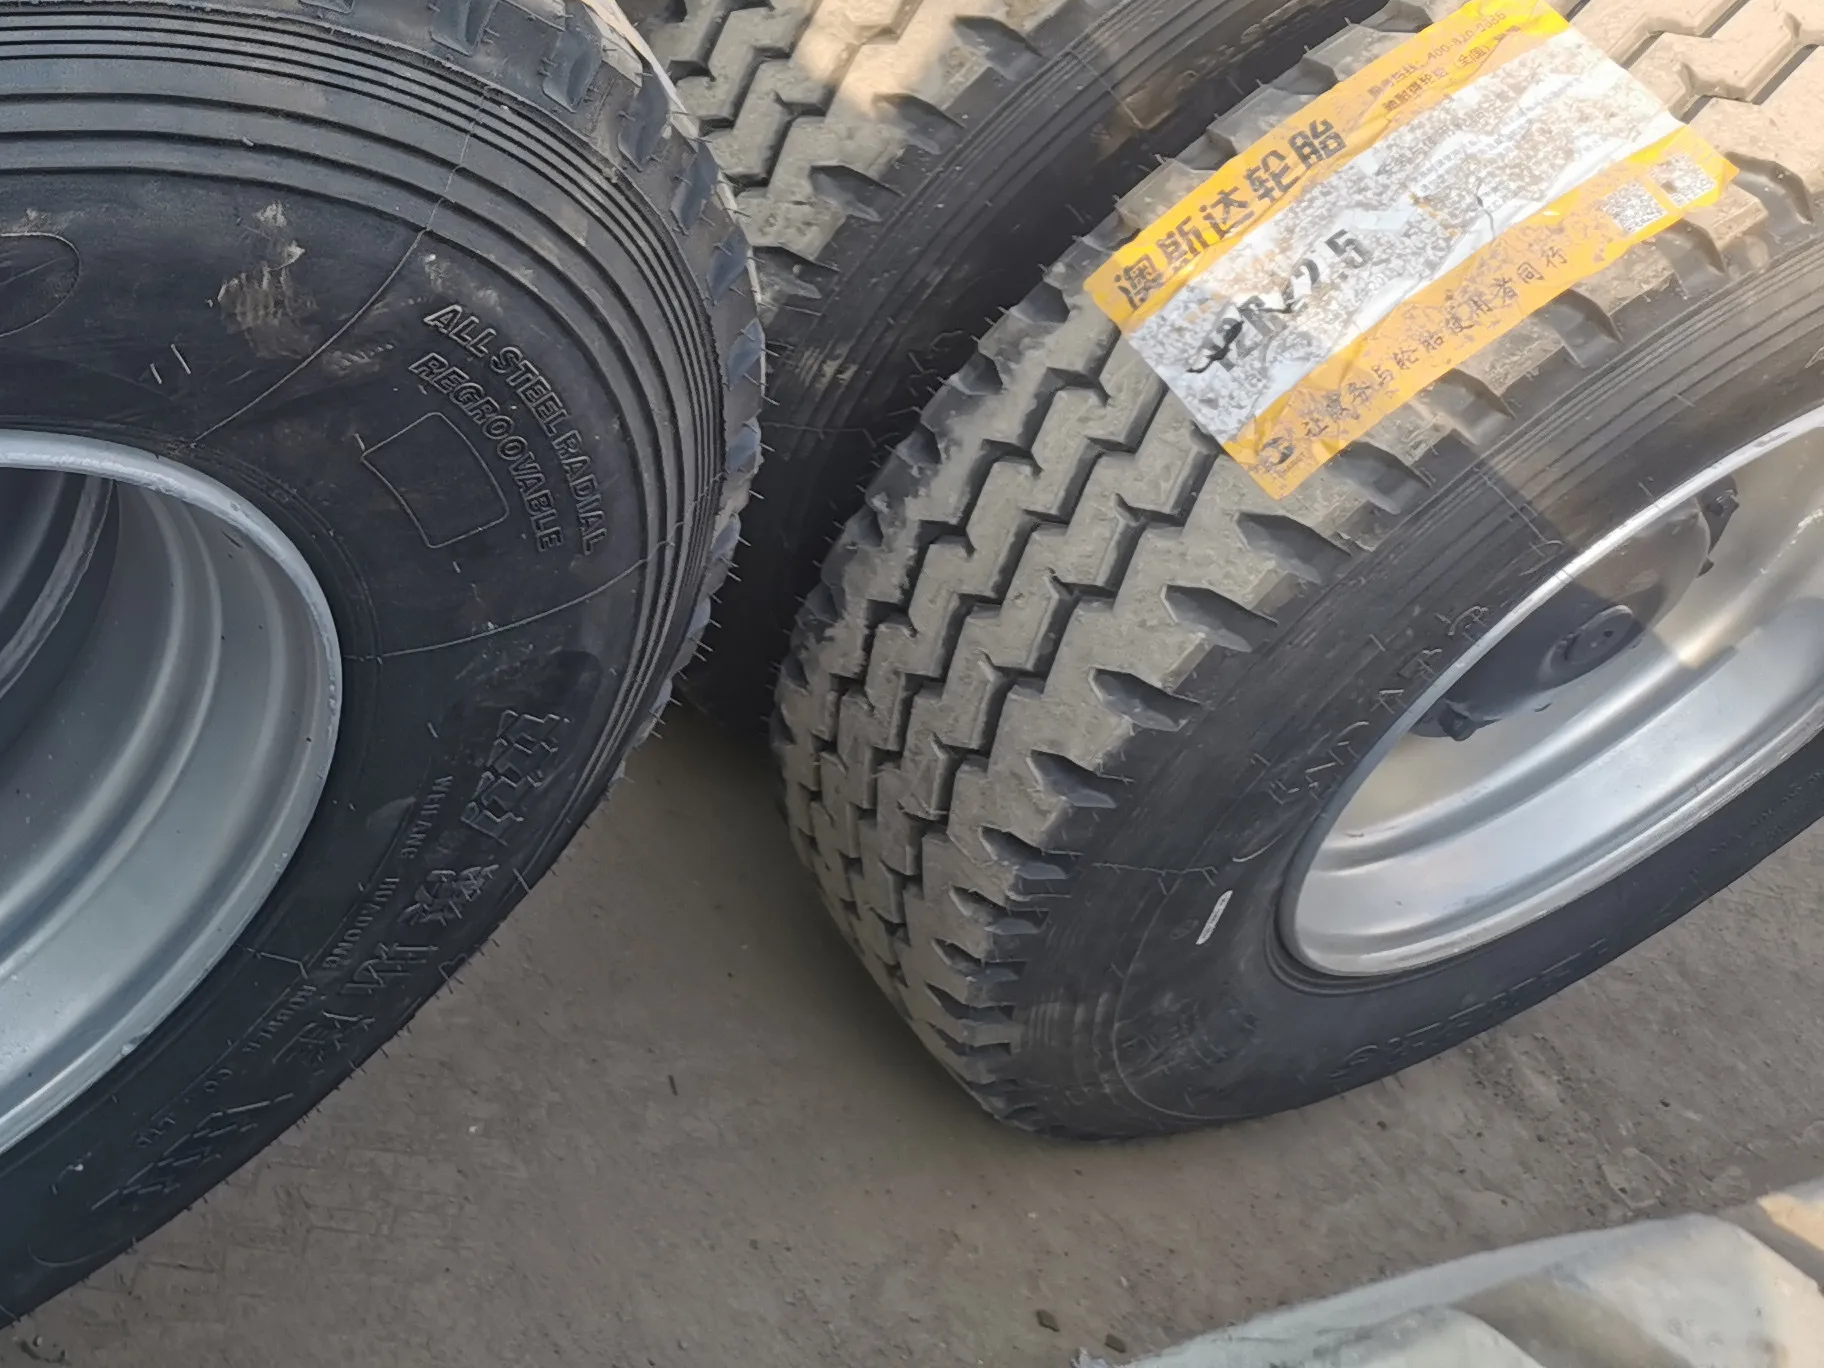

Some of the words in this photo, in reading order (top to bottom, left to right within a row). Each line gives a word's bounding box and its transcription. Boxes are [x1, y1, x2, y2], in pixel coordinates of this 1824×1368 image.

[1112, 117, 1348, 312] 澳斯达轮胎
[409, 352, 564, 553] REGROOVABLE
[423, 304, 496, 359] ALL
[490, 346, 569, 438] STEEL
[552, 430, 608, 556] RADIAL
